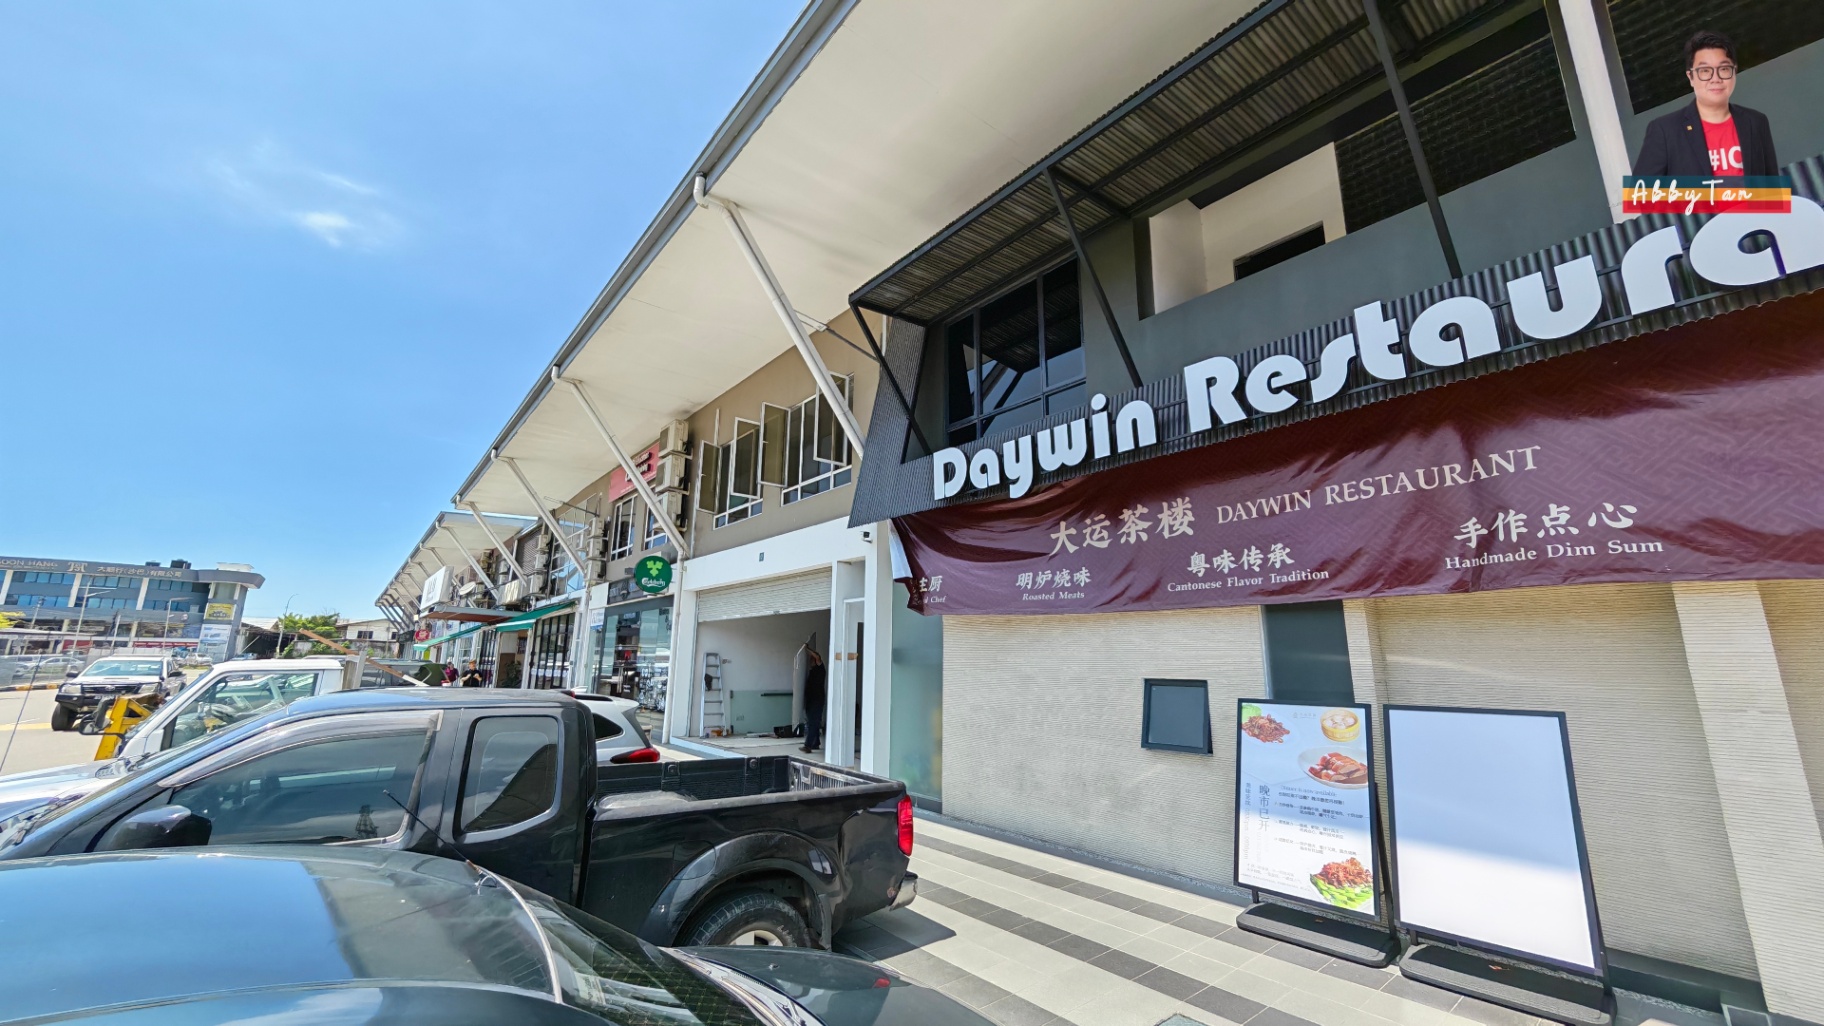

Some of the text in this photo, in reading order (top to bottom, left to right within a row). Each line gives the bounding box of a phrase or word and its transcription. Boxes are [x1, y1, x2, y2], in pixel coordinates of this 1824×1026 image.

[933, 392, 1158, 500] Daywin
[1216, 444, 1542, 524] DAYWIN RESTAURANT
[1049, 496, 1195, 556] 大运茶楼
[1453, 502, 1638, 549] 手作点心
[1186, 542, 1295, 577] 粤味传承
[1444, 538, 1664, 570] Handmade Dim Sum
[1015, 566, 1092, 590] 明炉烧味
[1167, 568, 1330, 592] Cantonese Flavor Tradition
[930, 595, 947, 603] Chef
[1022, 591, 1085, 601] Roasted Meats
[1257, 784, 1271, 832] 晚市已开
